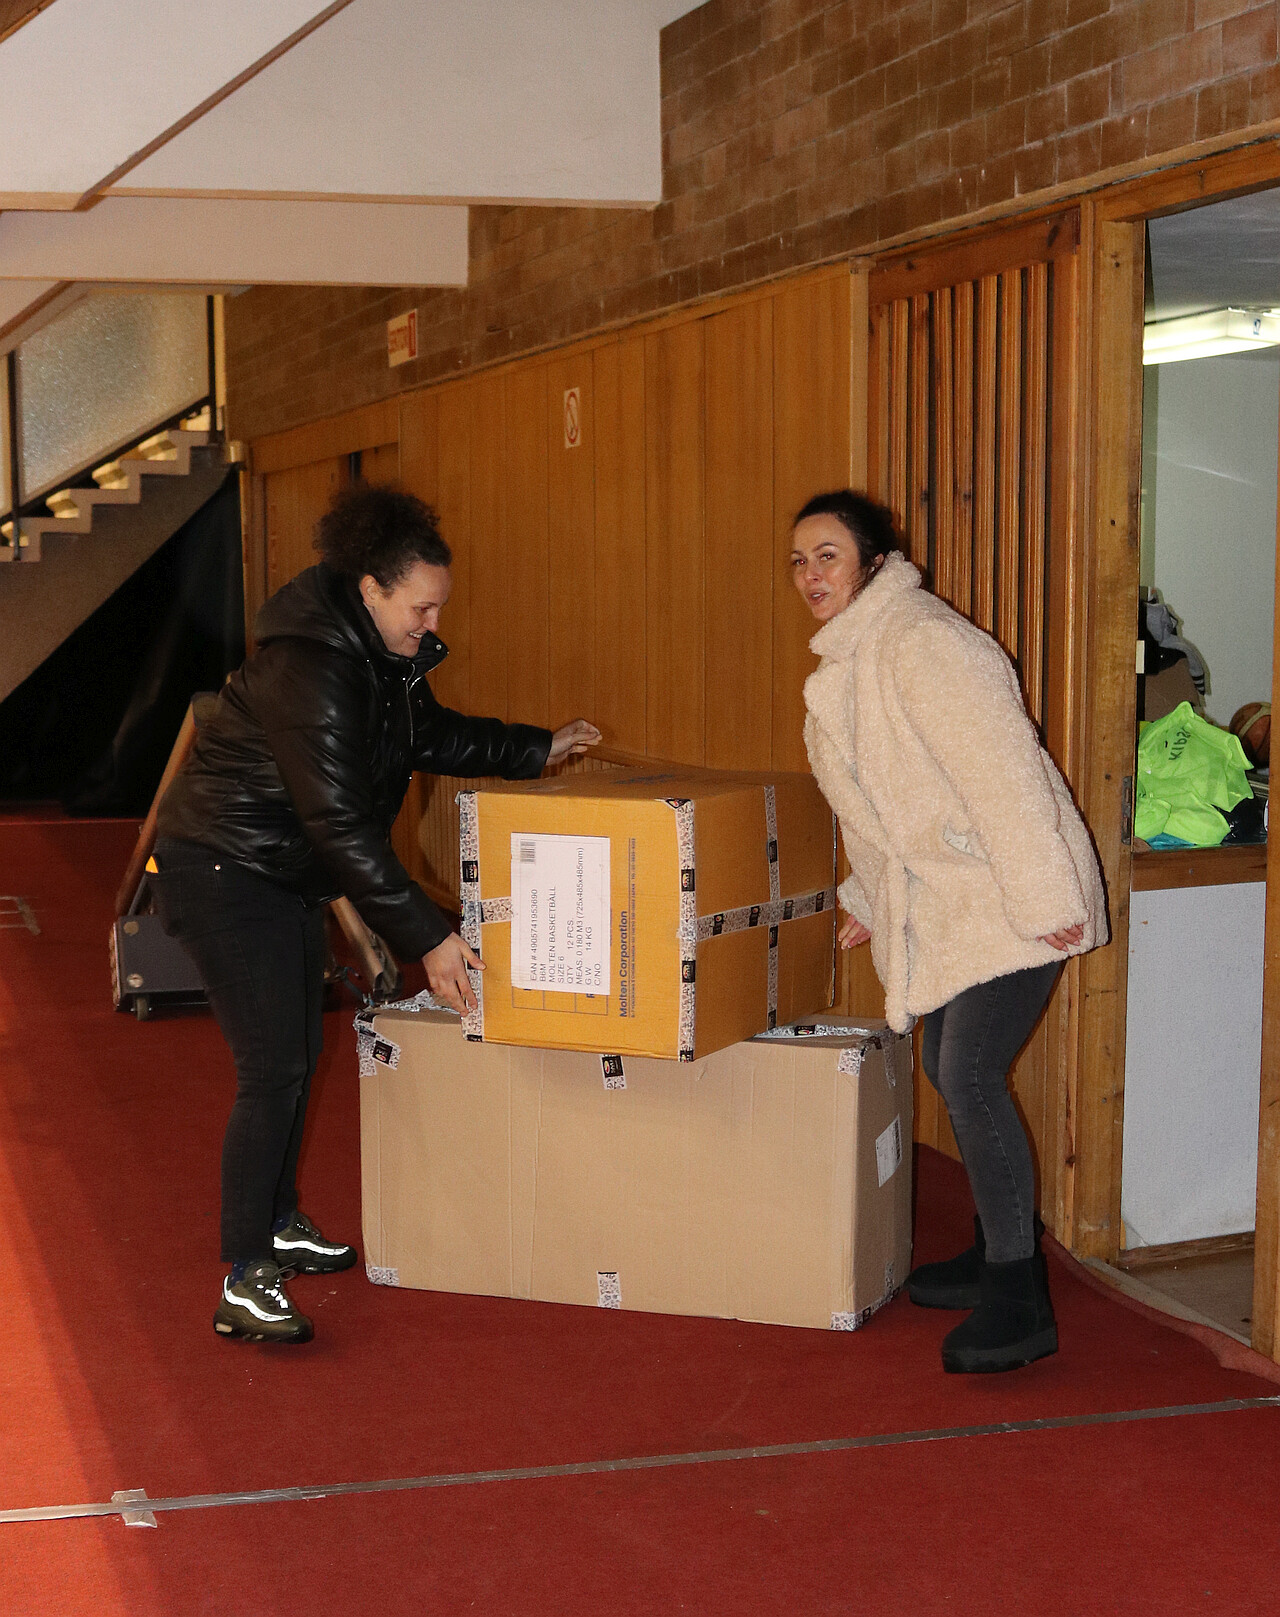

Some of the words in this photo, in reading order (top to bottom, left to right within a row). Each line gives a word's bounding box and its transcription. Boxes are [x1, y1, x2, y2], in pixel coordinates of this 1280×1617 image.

[576, 847, 584, 919] (725x485x485mm)
[576, 920, 583, 933] M3
[585, 926, 592, 940] KG
[567, 940, 574, 950] 12
[585, 941, 592, 951] 14
[619, 910, 629, 978] Corporation
[530, 962, 538, 981] EAN
[619, 980, 628, 1018] Molten
